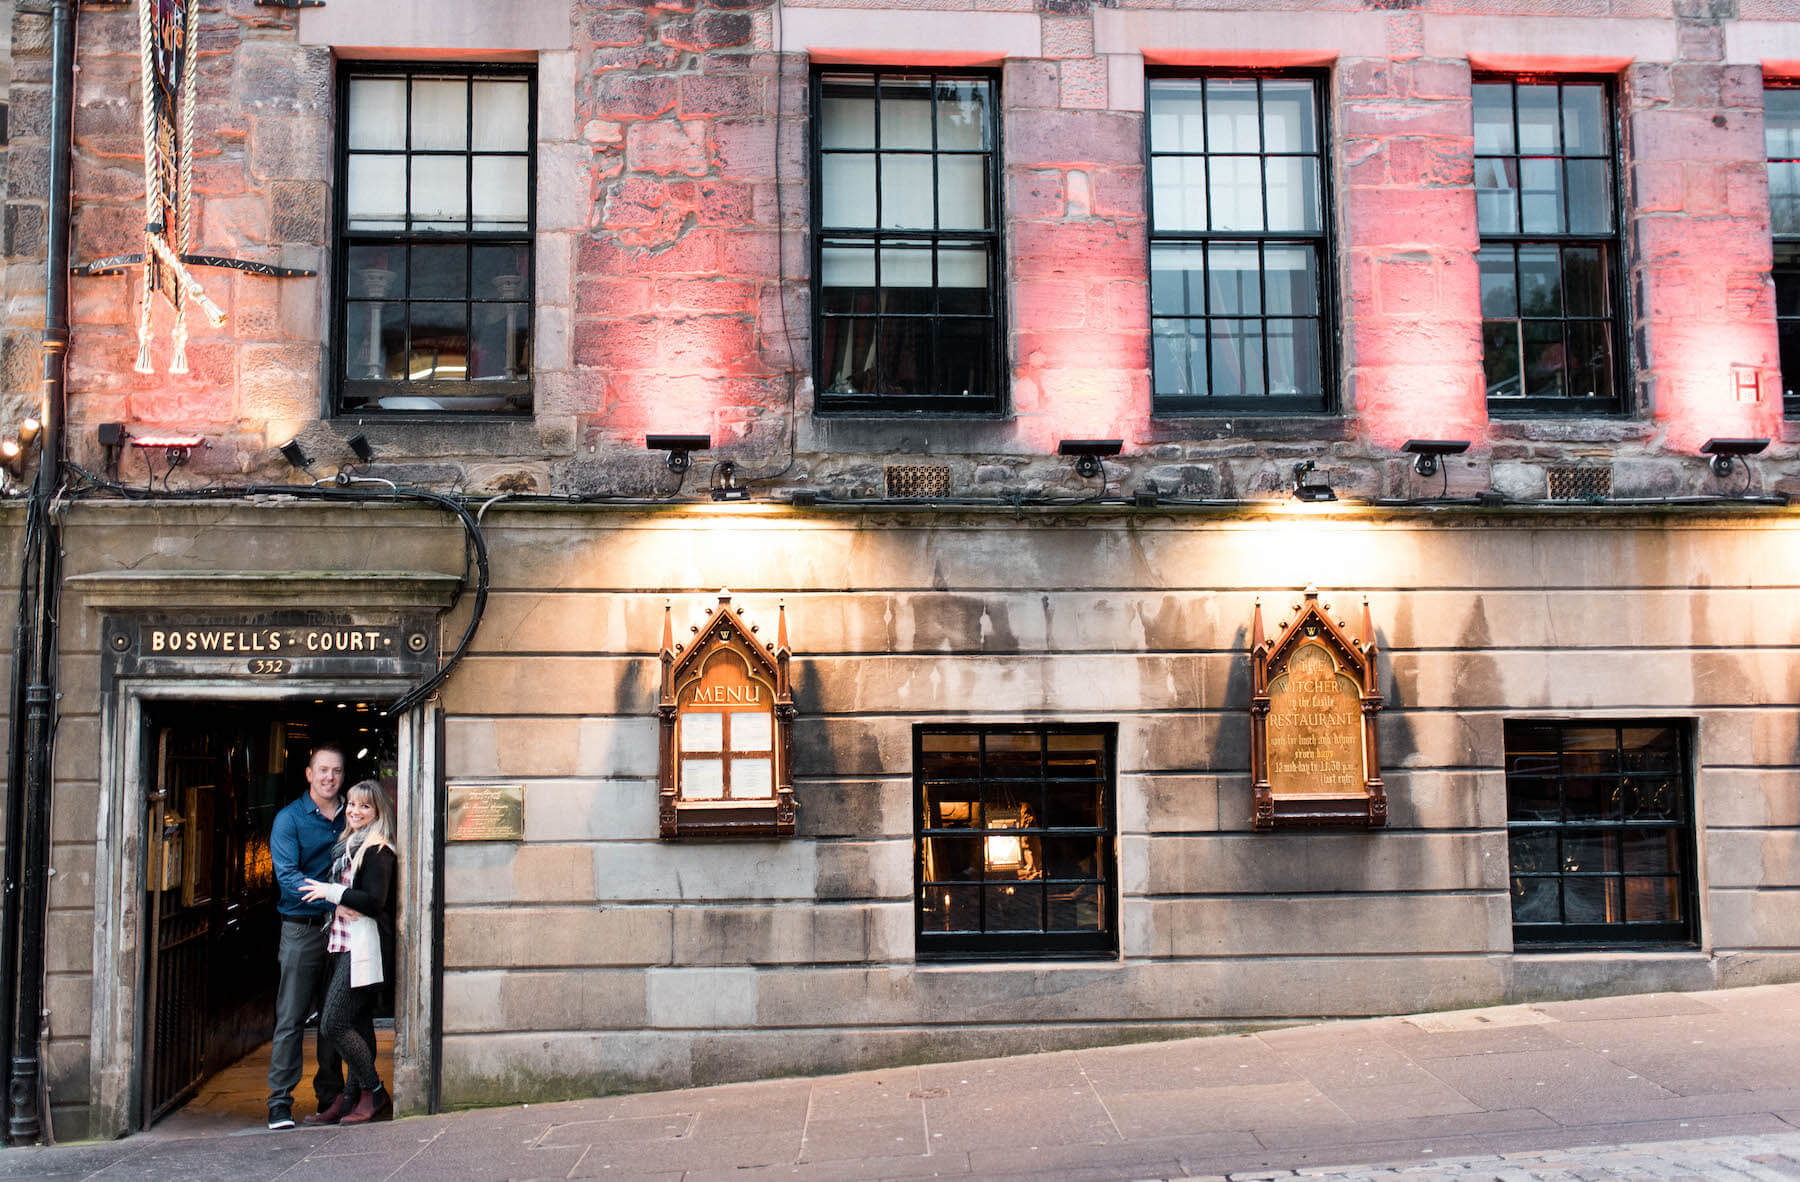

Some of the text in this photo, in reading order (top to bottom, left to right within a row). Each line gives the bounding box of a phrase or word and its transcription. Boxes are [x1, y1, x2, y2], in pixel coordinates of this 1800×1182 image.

[720, 631, 729, 640] W
[1306, 626, 1316, 636] W
[307, 631, 380, 651] COURT
[255, 660, 283, 674] 352
[1300, 661, 1326, 672] THE
[1279, 680, 1344, 693] WITCHERY
[694, 686, 760, 703] MENU
[1270, 712, 1353, 729] RESTAURANT
